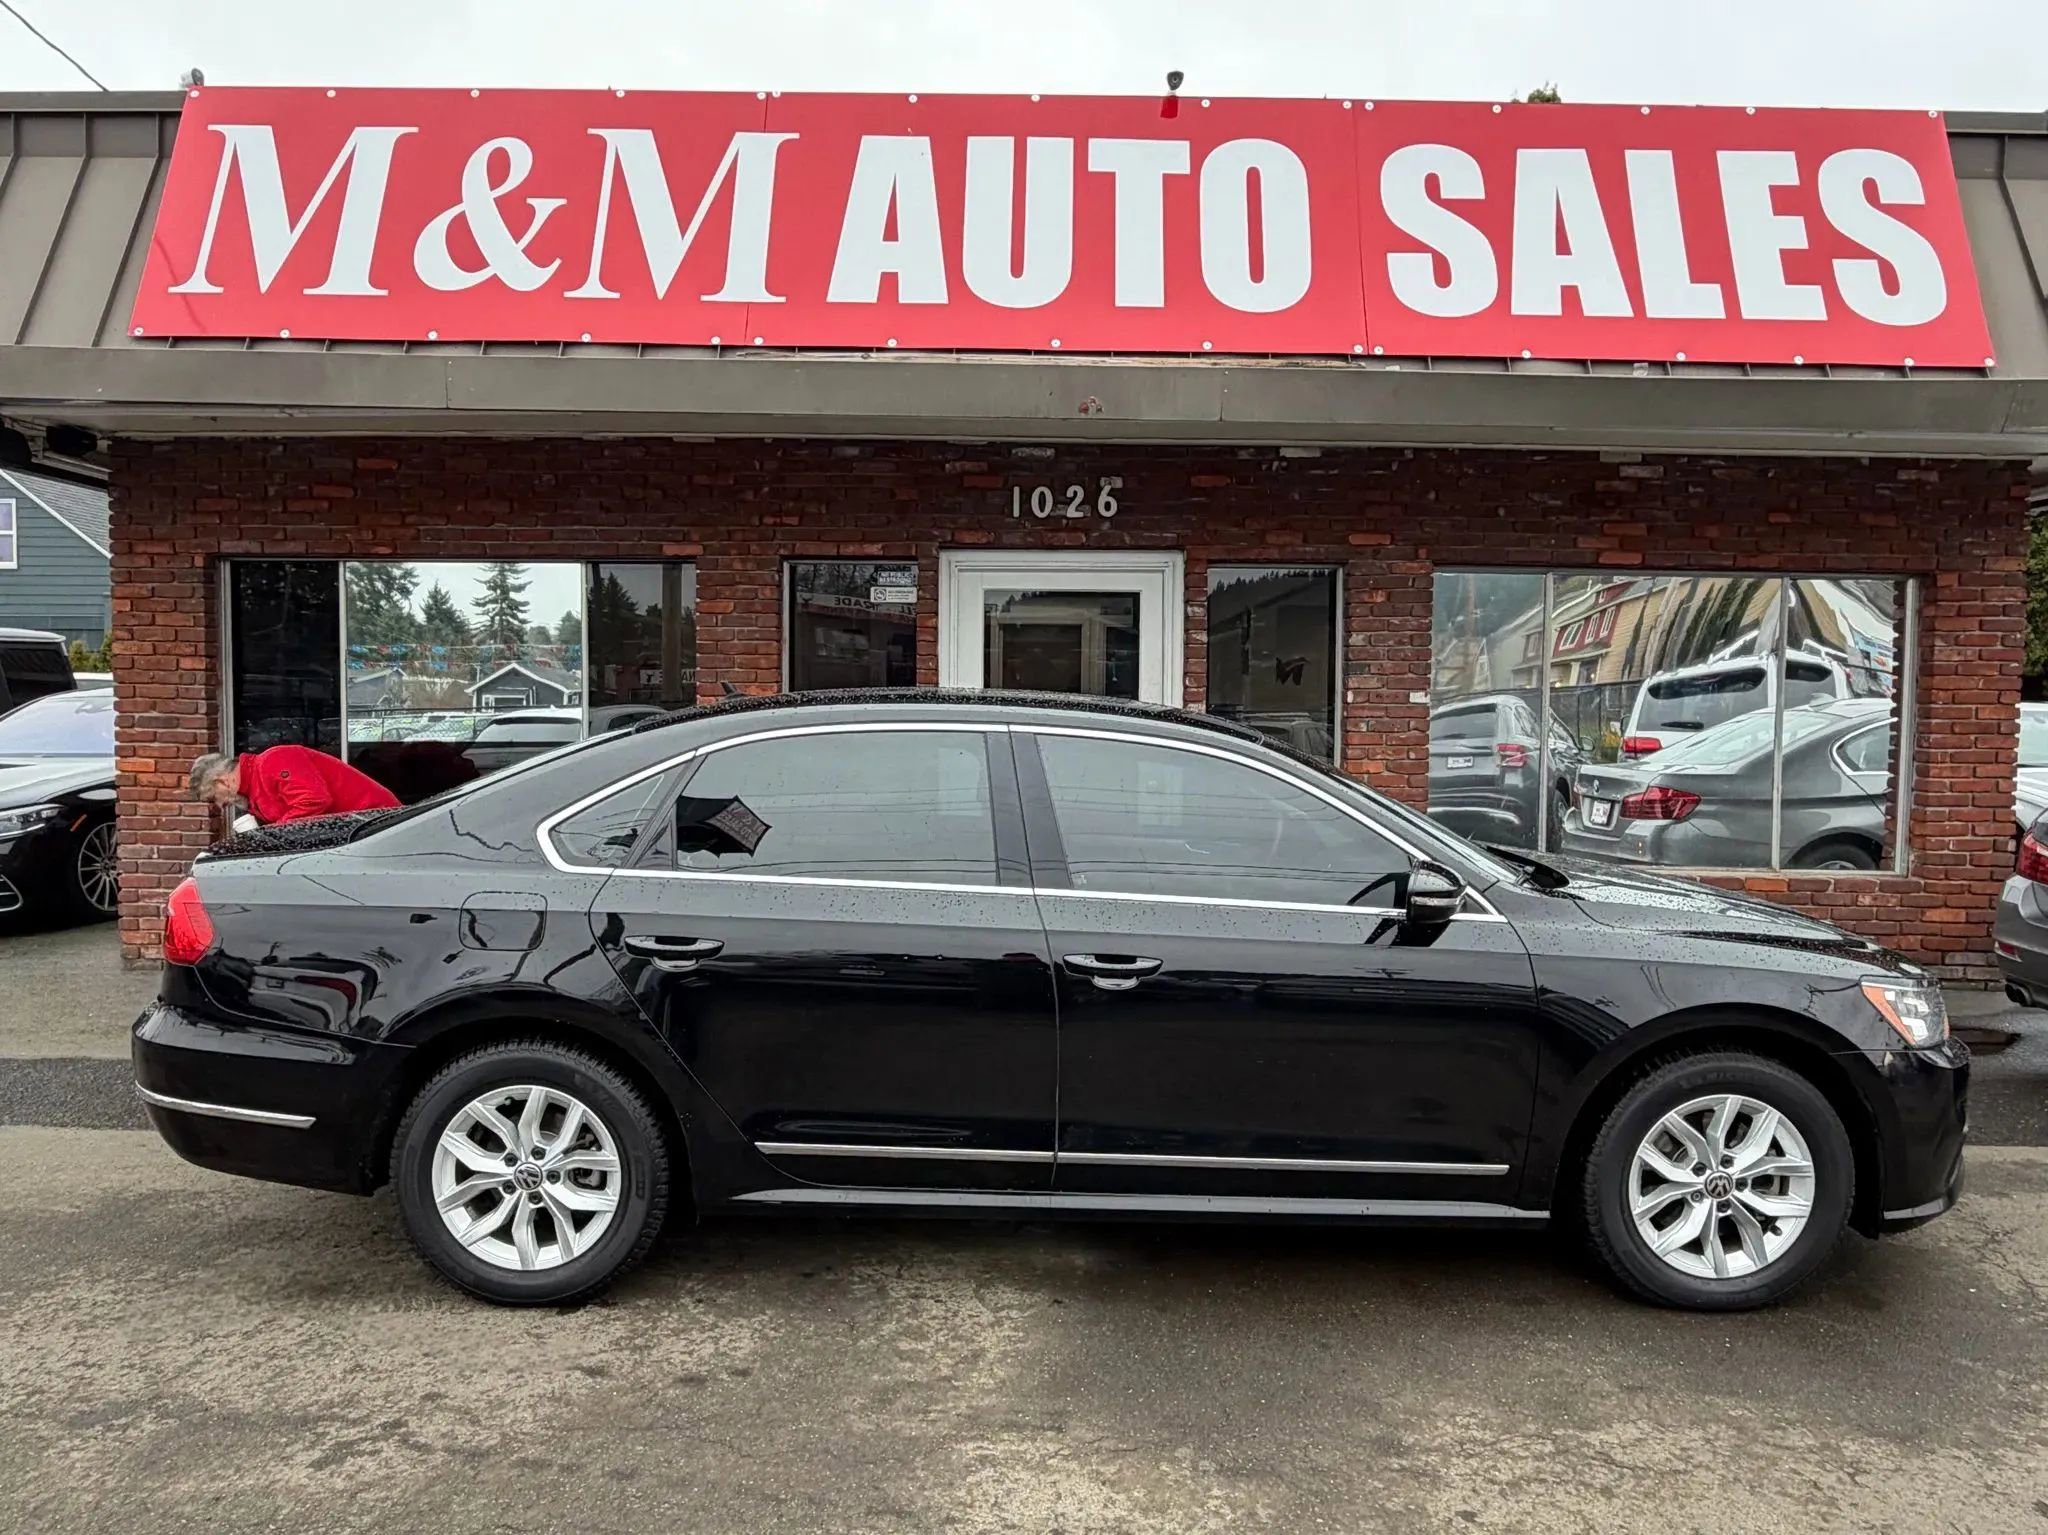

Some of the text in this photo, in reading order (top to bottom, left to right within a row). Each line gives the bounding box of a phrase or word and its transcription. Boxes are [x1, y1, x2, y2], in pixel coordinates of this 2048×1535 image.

[827, 135, 1312, 313] AUTO
[1380, 143, 1947, 327] SALES
[1012, 484, 1119, 519] 1026
